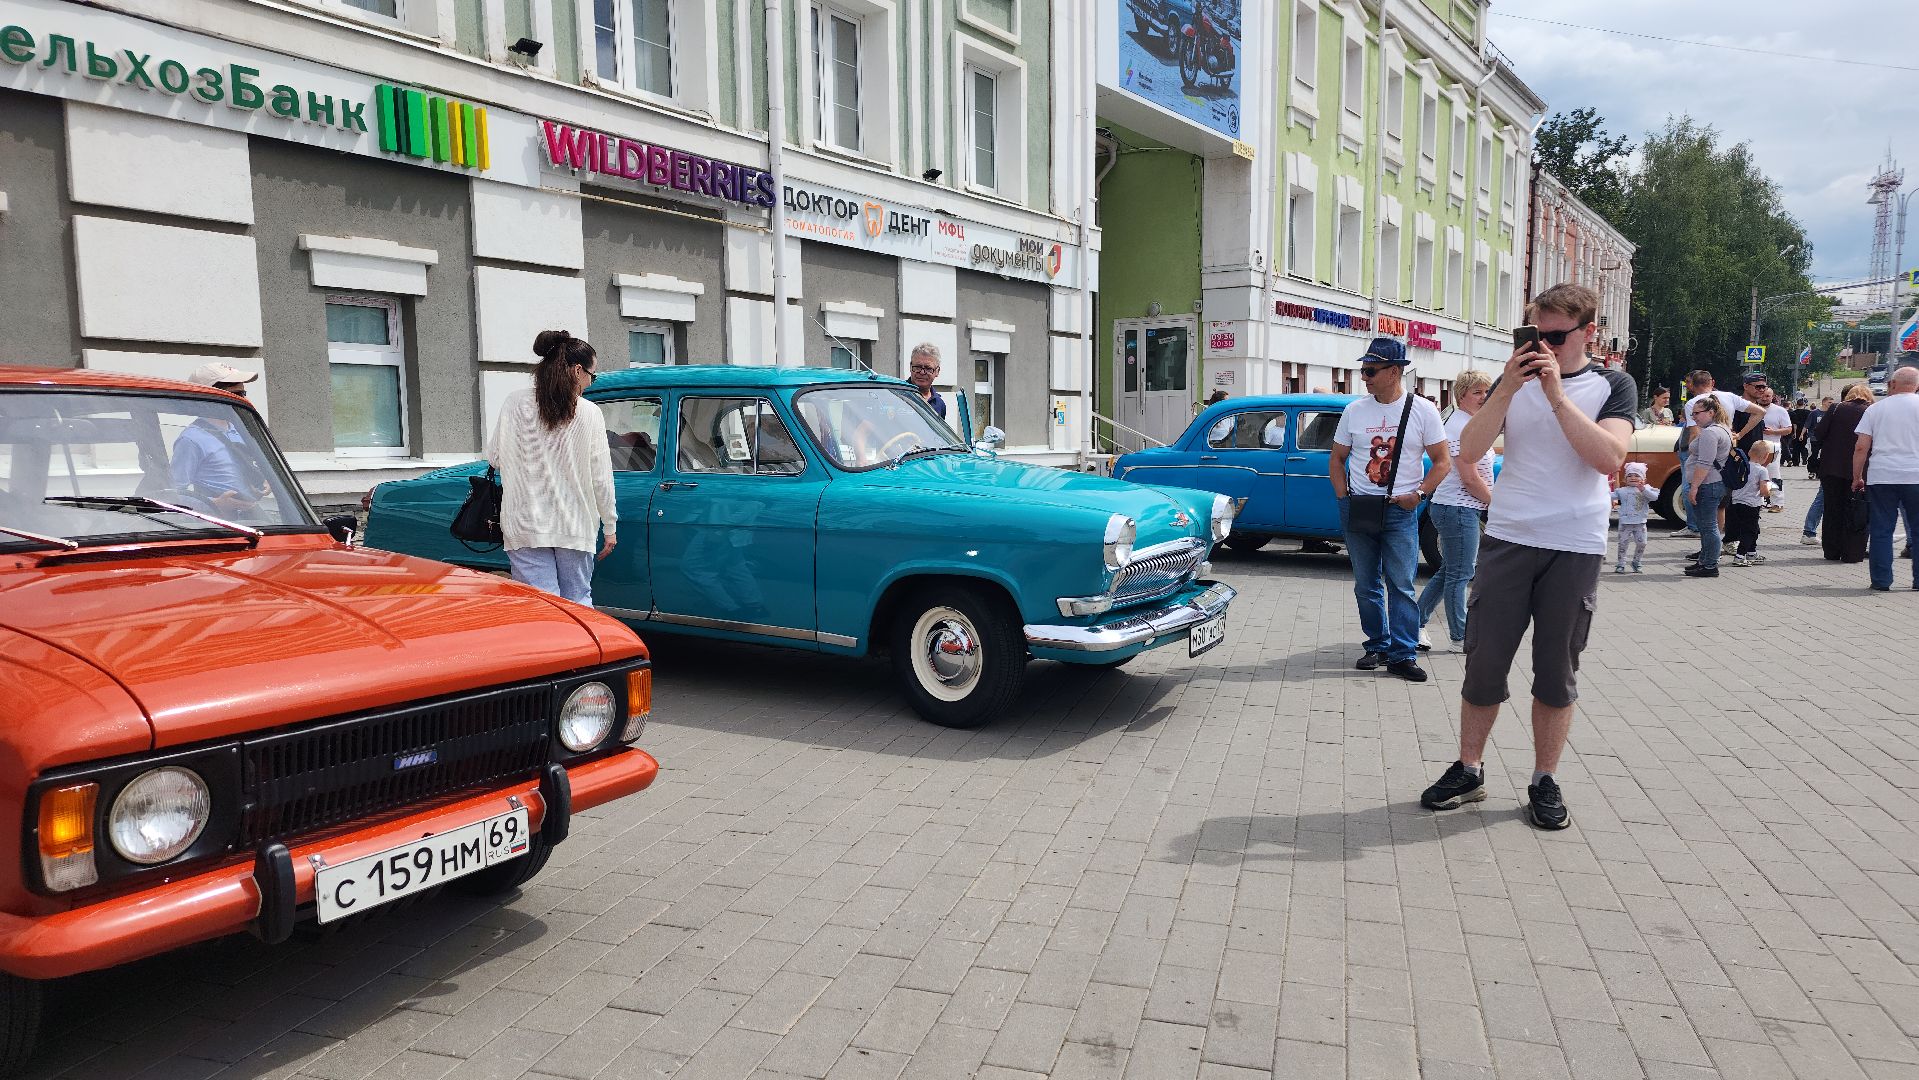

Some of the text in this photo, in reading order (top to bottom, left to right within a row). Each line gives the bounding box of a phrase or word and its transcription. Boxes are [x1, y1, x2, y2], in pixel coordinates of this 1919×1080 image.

[542, 120, 777, 208] WILDBERRIES
[784, 186, 930, 236] ДОКТОР ДЕНТ
[784, 217, 855, 241] ТОМАТОЛОГИЯ
[938, 220, 964, 241] МФЦ
[489, 816, 519, 848] 69
